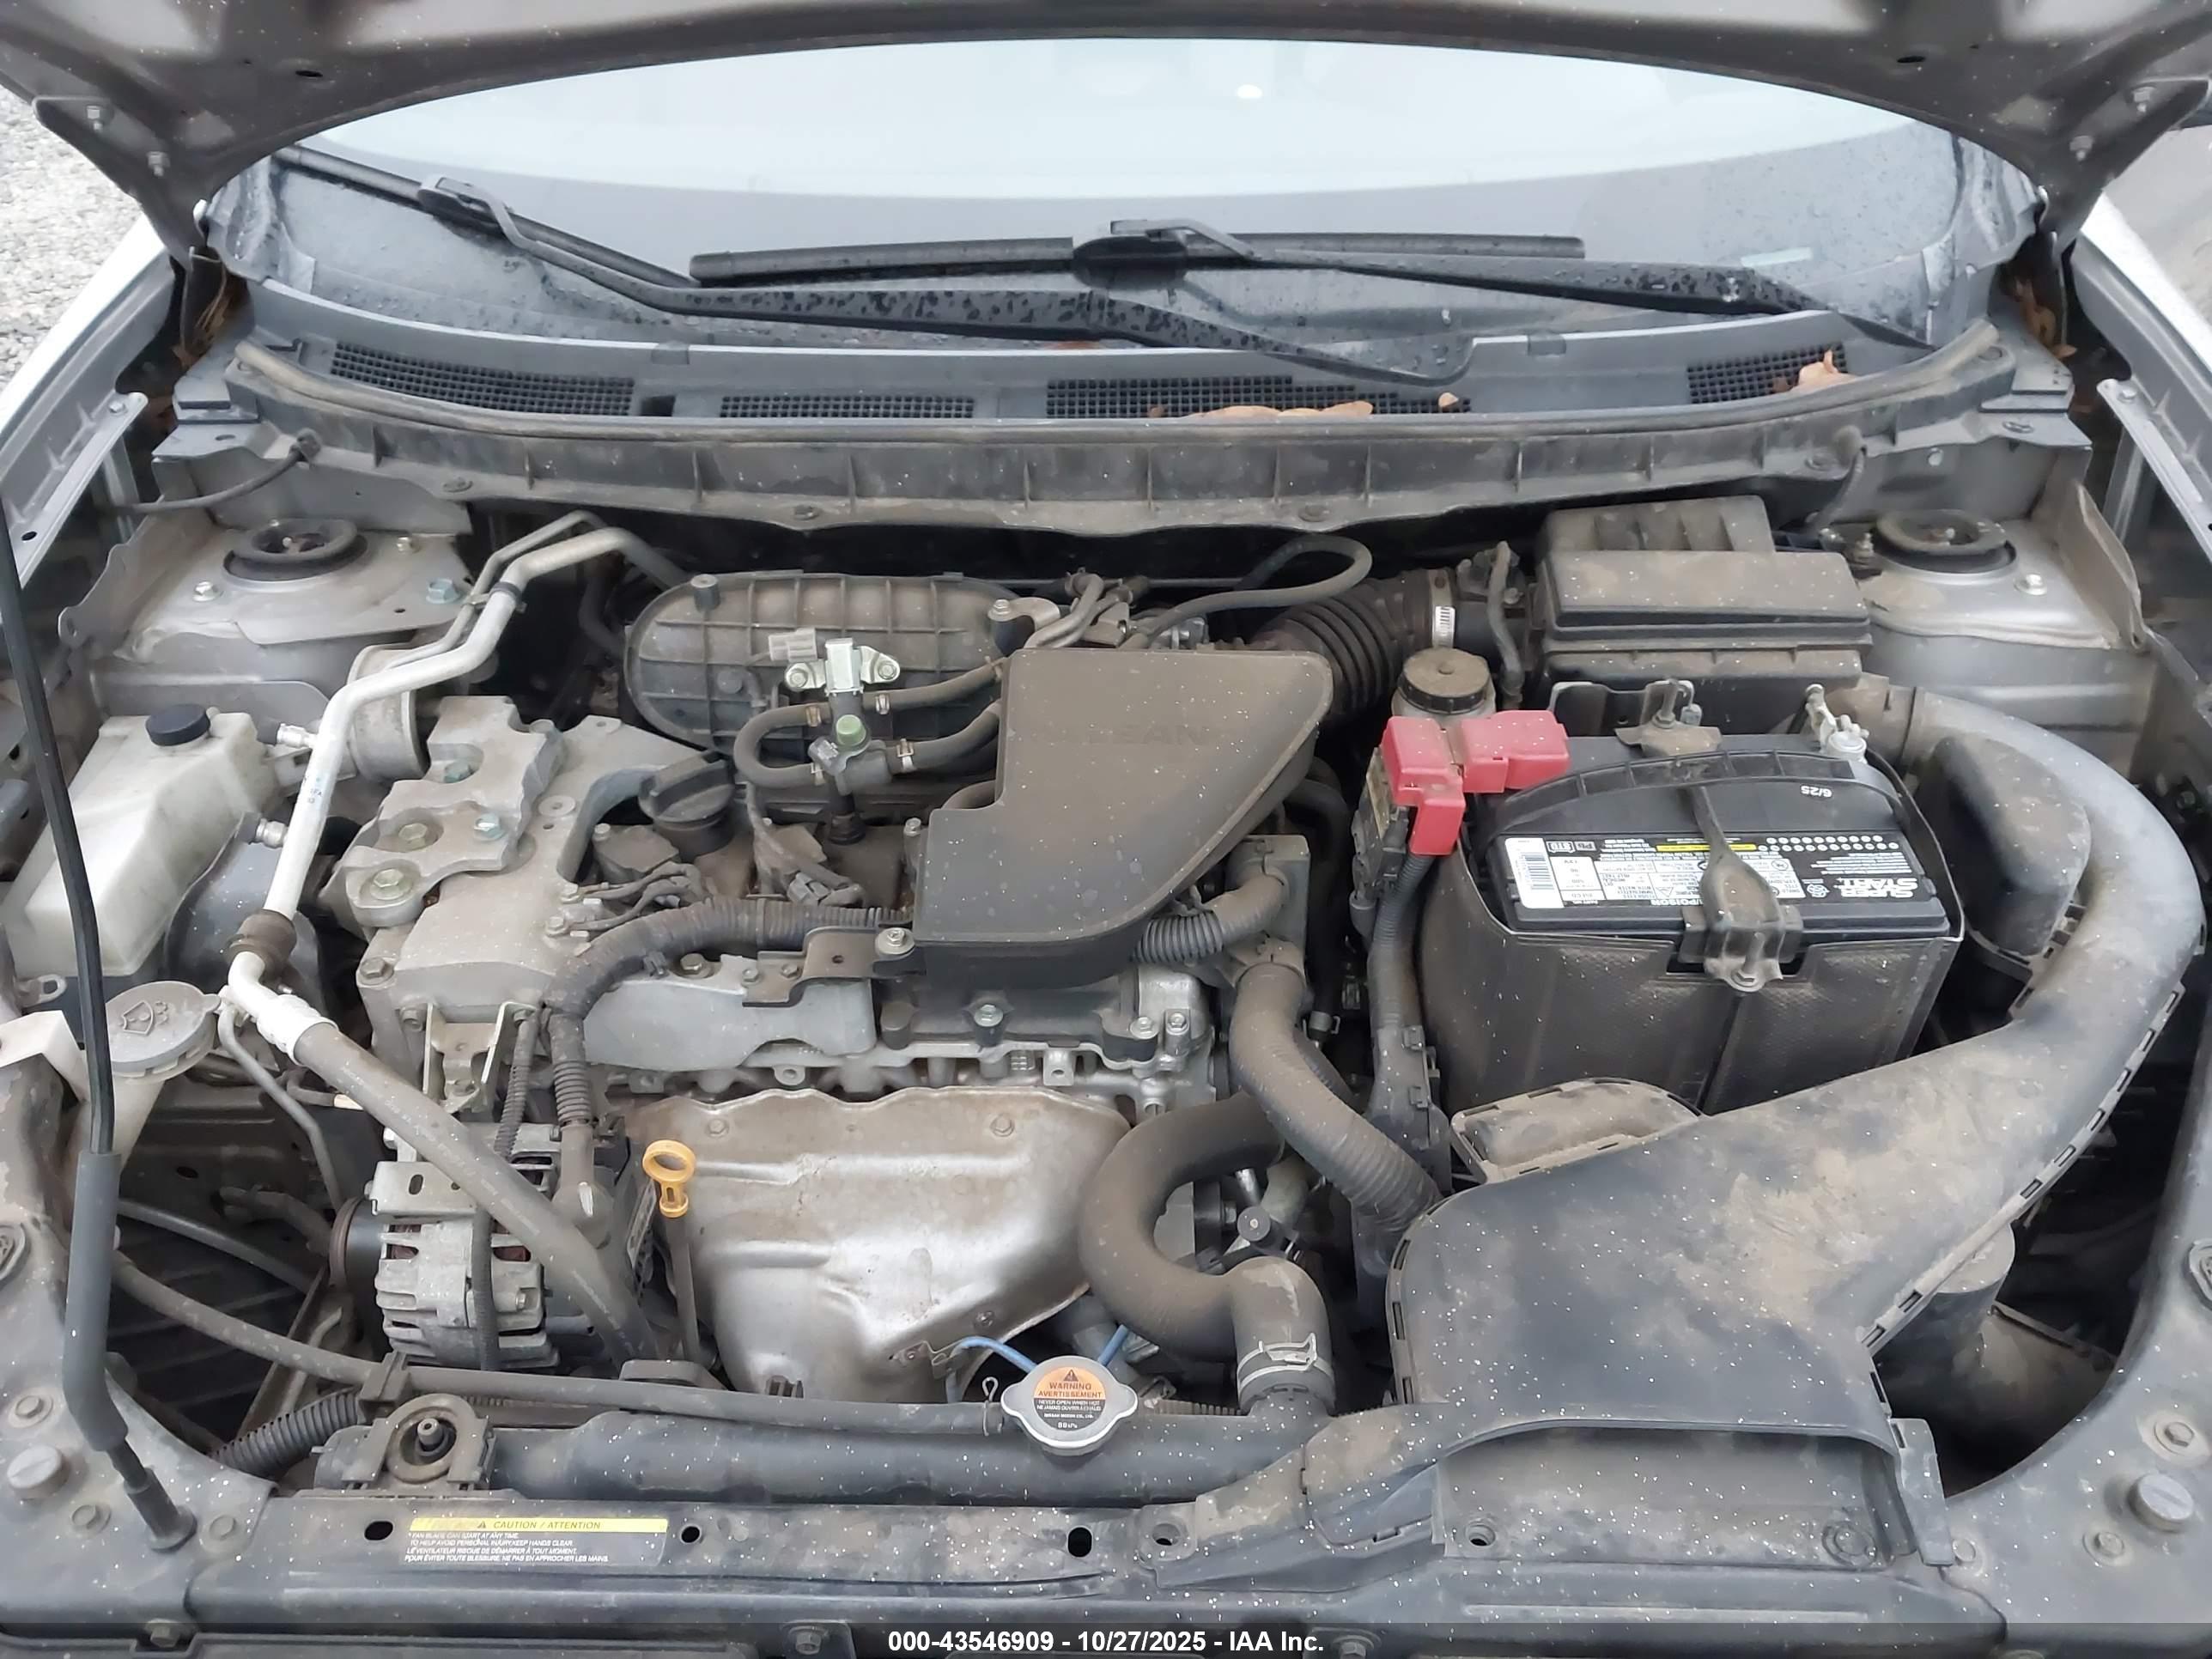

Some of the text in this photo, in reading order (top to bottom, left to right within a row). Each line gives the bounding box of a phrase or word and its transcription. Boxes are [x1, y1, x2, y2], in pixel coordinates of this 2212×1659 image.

[1801, 785, 1832, 798] 6/25
[1840, 889, 1913, 898] SUPER
[1049, 1382, 1092, 1390] WARNING
[493, 1521, 537, 1529] CAUTION
[547, 1521, 601, 1529] ATTENTION
